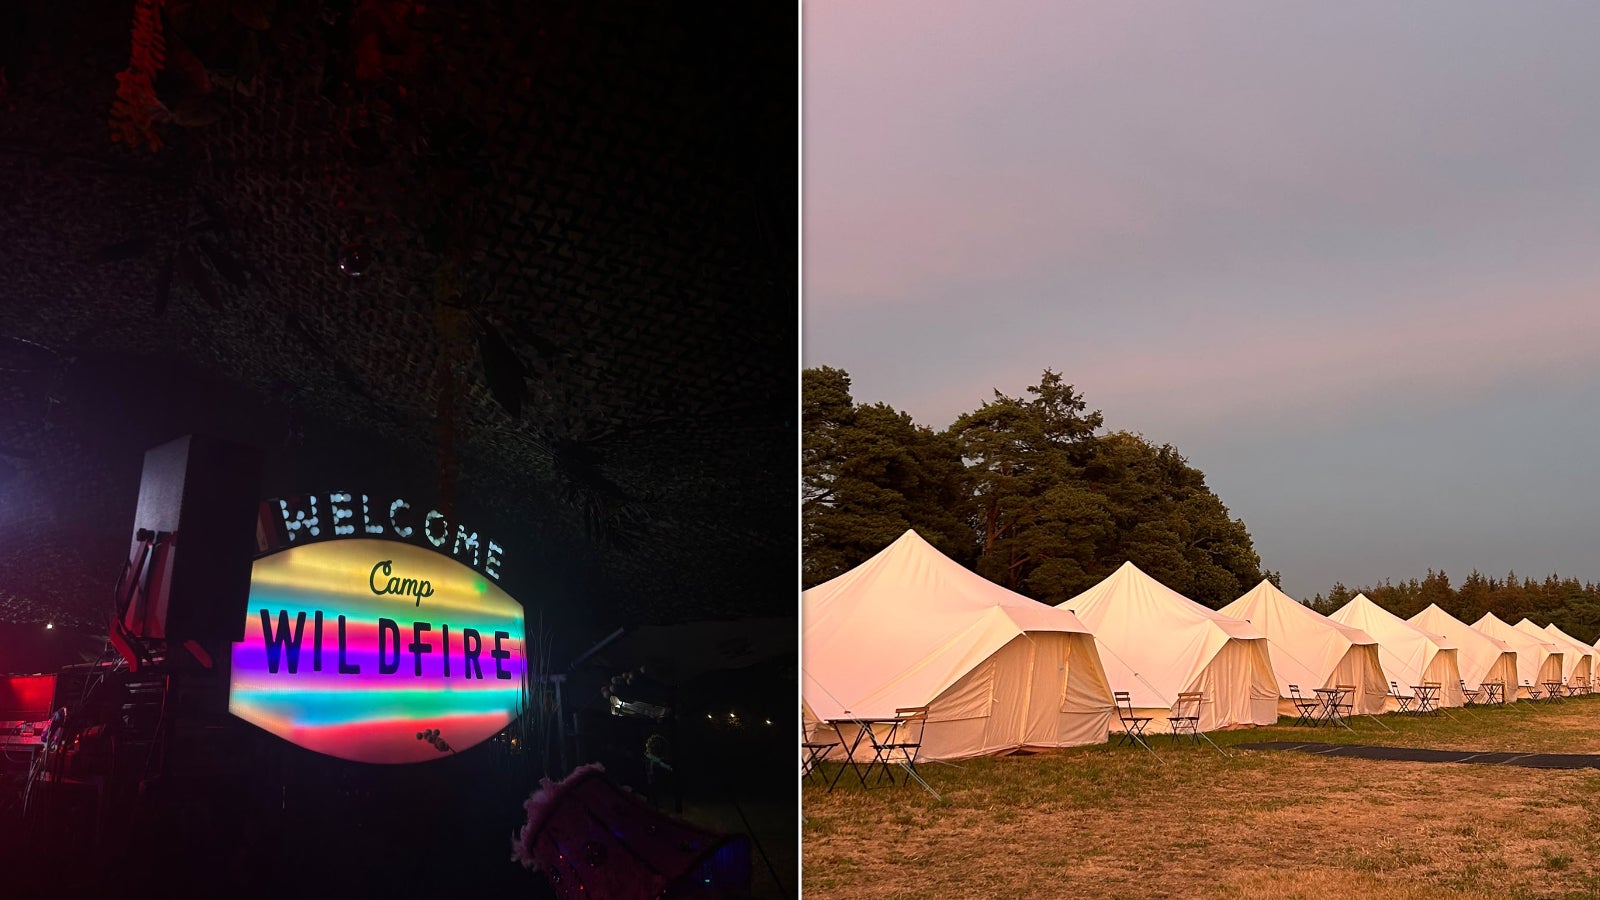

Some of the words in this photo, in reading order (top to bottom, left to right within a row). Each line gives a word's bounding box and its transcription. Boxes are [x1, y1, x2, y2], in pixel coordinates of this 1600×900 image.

[280, 493, 503, 580] WELCOME
[369, 560, 434, 607] Camp
[260, 608, 512, 680] WILDFIRE
